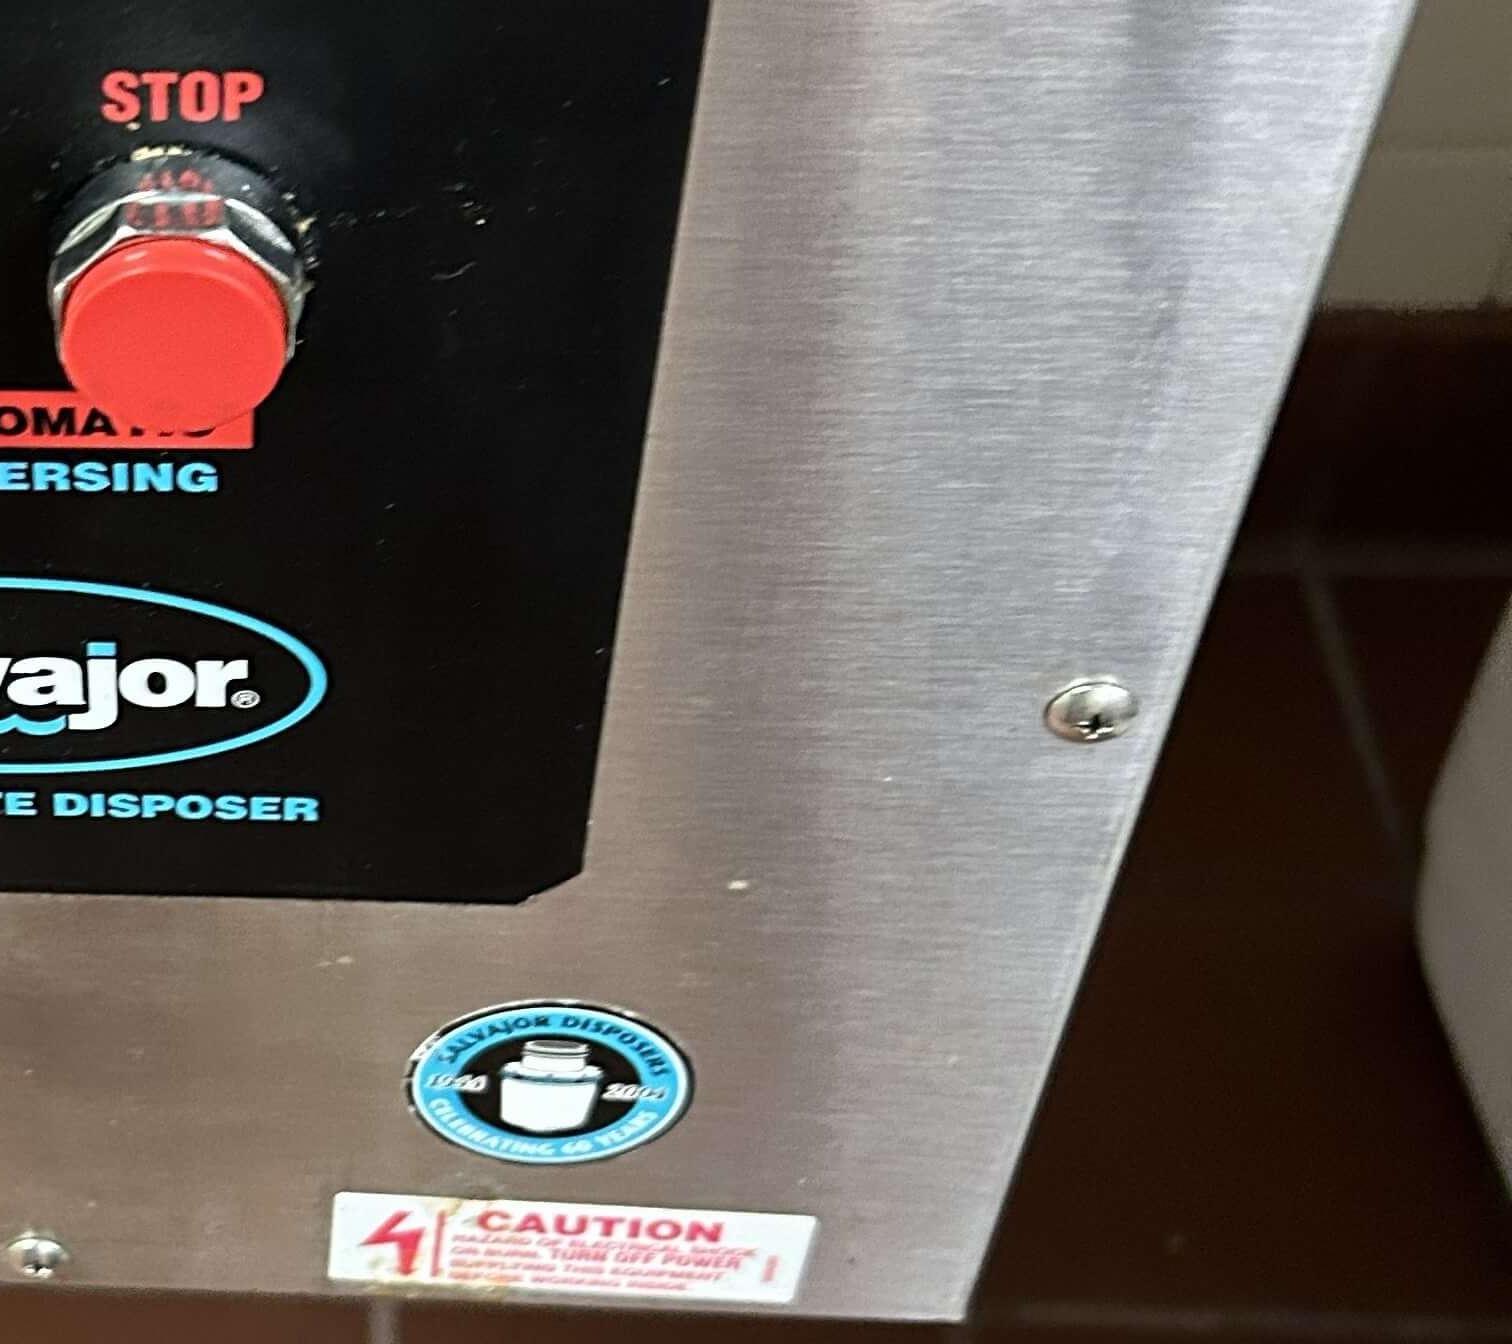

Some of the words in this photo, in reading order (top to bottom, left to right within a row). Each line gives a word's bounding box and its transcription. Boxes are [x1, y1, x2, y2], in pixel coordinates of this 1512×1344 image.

[100, 70, 265, 123] STOP
[53, 792, 321, 823] DISPOSER
[439, 1014, 552, 1064] SALVAJOR
[560, 1014, 671, 1077] DISPOSERS
[476, 1209, 724, 1242] CAUTION
[550, 1247, 608, 1262] TURN
[614, 1250, 657, 1265] OFF
[661, 1253, 741, 1271] POWER
